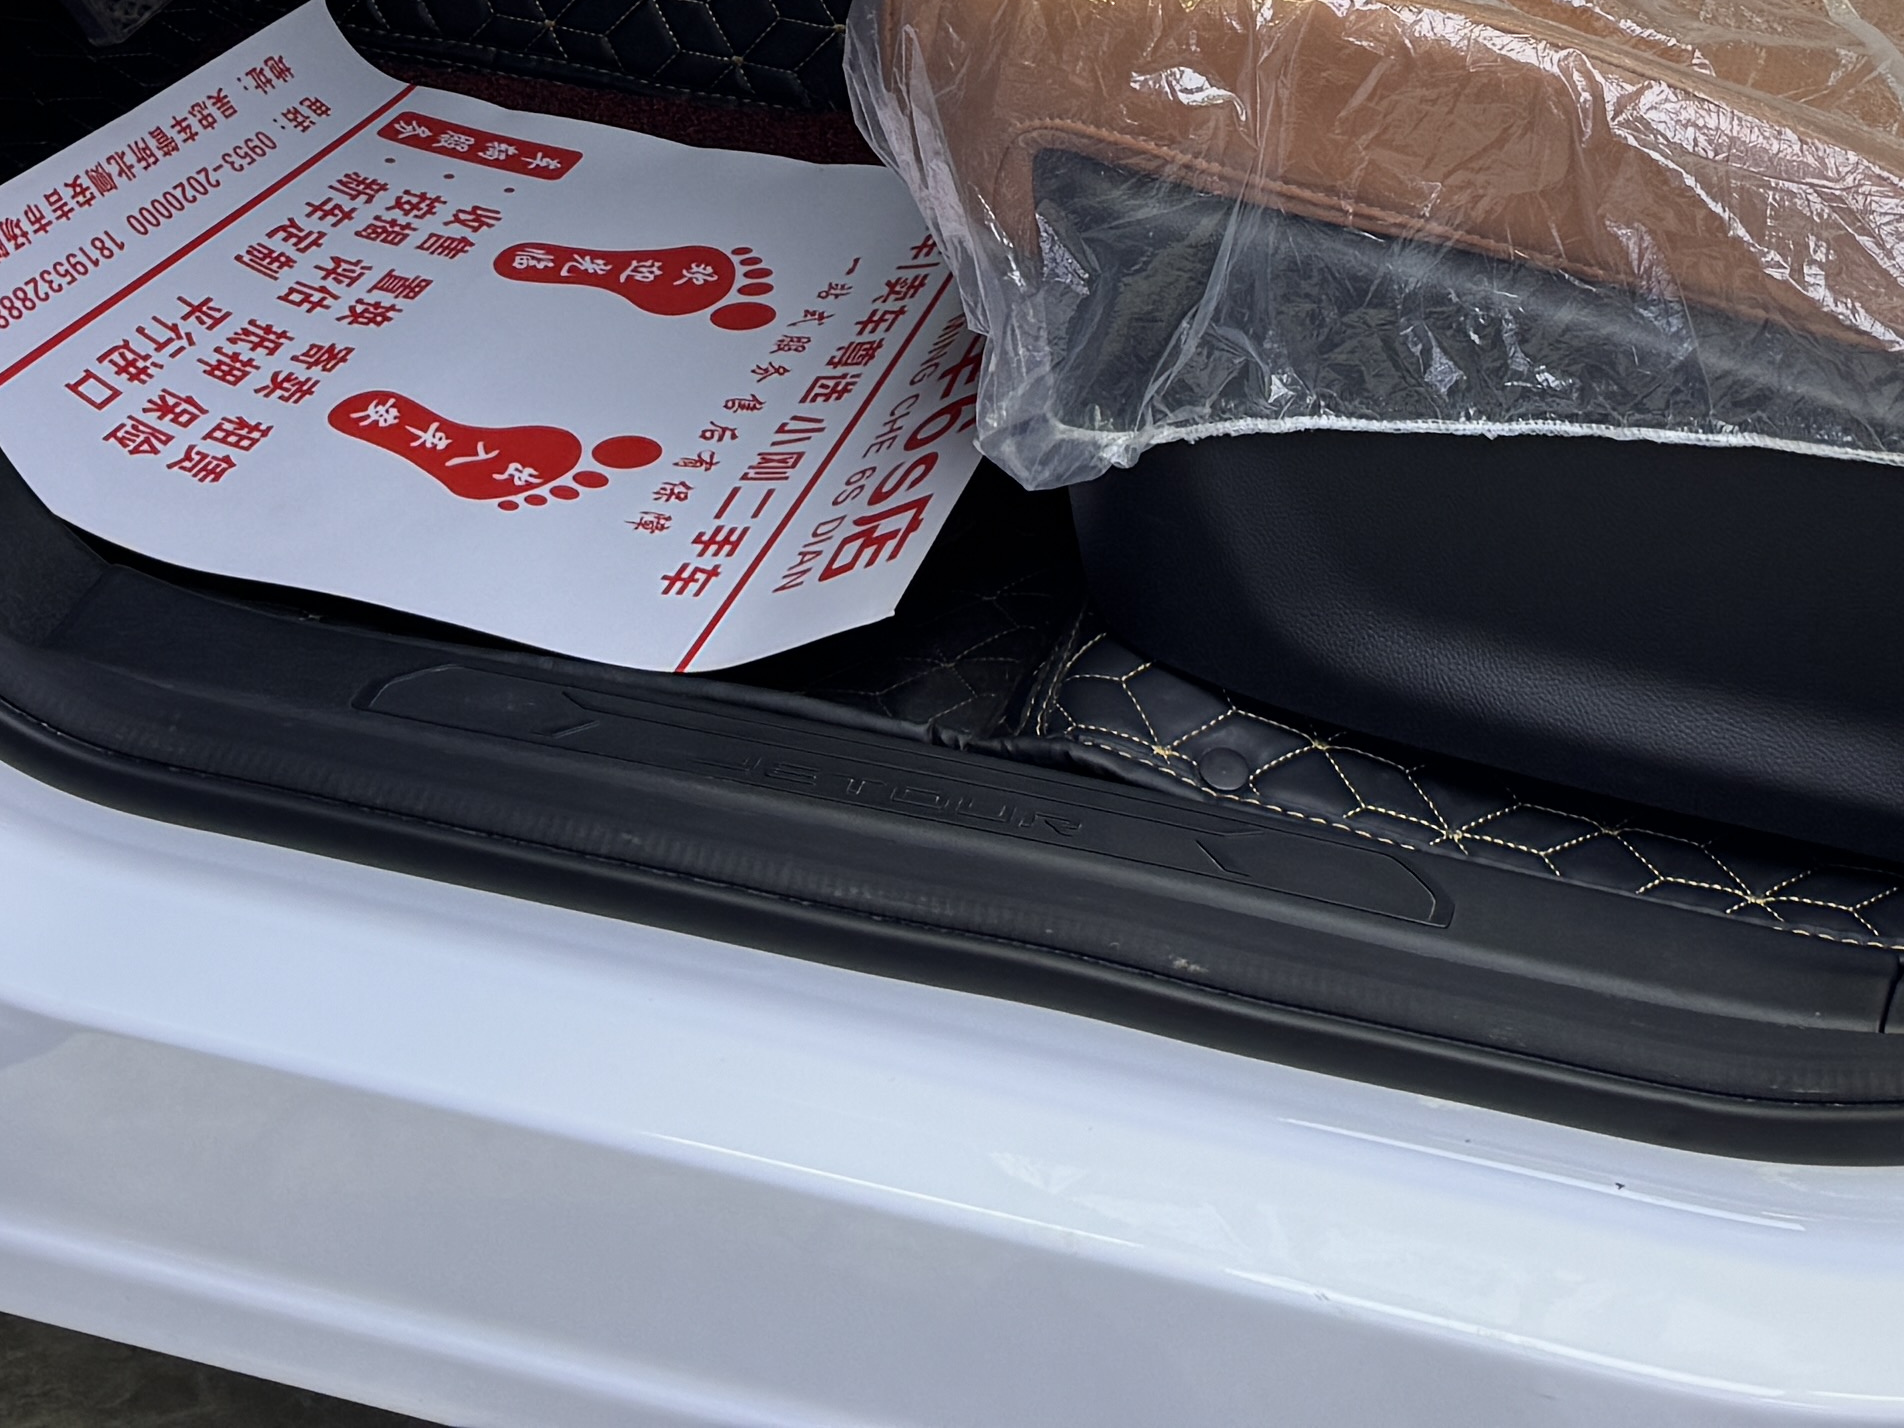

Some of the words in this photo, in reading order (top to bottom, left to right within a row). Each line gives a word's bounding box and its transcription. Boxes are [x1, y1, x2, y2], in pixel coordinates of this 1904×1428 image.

[393, 119, 562, 170] 车辆服务
[127, 130, 278, 236] 0953-2020000
[234, 173, 391, 279] 新车定制
[355, 188, 449, 247] 按揭
[417, 206, 500, 259] 收售
[277, 265, 369, 314] 评估
[347, 270, 435, 328] 置换
[511, 247, 719, 286] 欢迎光临
[66, 293, 229, 412] 平行进口
[749, 256, 863, 383] 一站式服务
[198, 320, 298, 387] 抵押
[256, 343, 356, 405] 寄卖
[104, 389, 209, 457] 保险
[167, 417, 273, 484] 租赁
[349, 397, 544, 486] 出入平安
[862, 393, 920, 459] CHE
[625, 394, 768, 533] 售后有保障
[831, 465, 878, 508] 6S
[659, 414, 825, 598] 小刚二手车
[775, 518, 836, 594] DIAN
